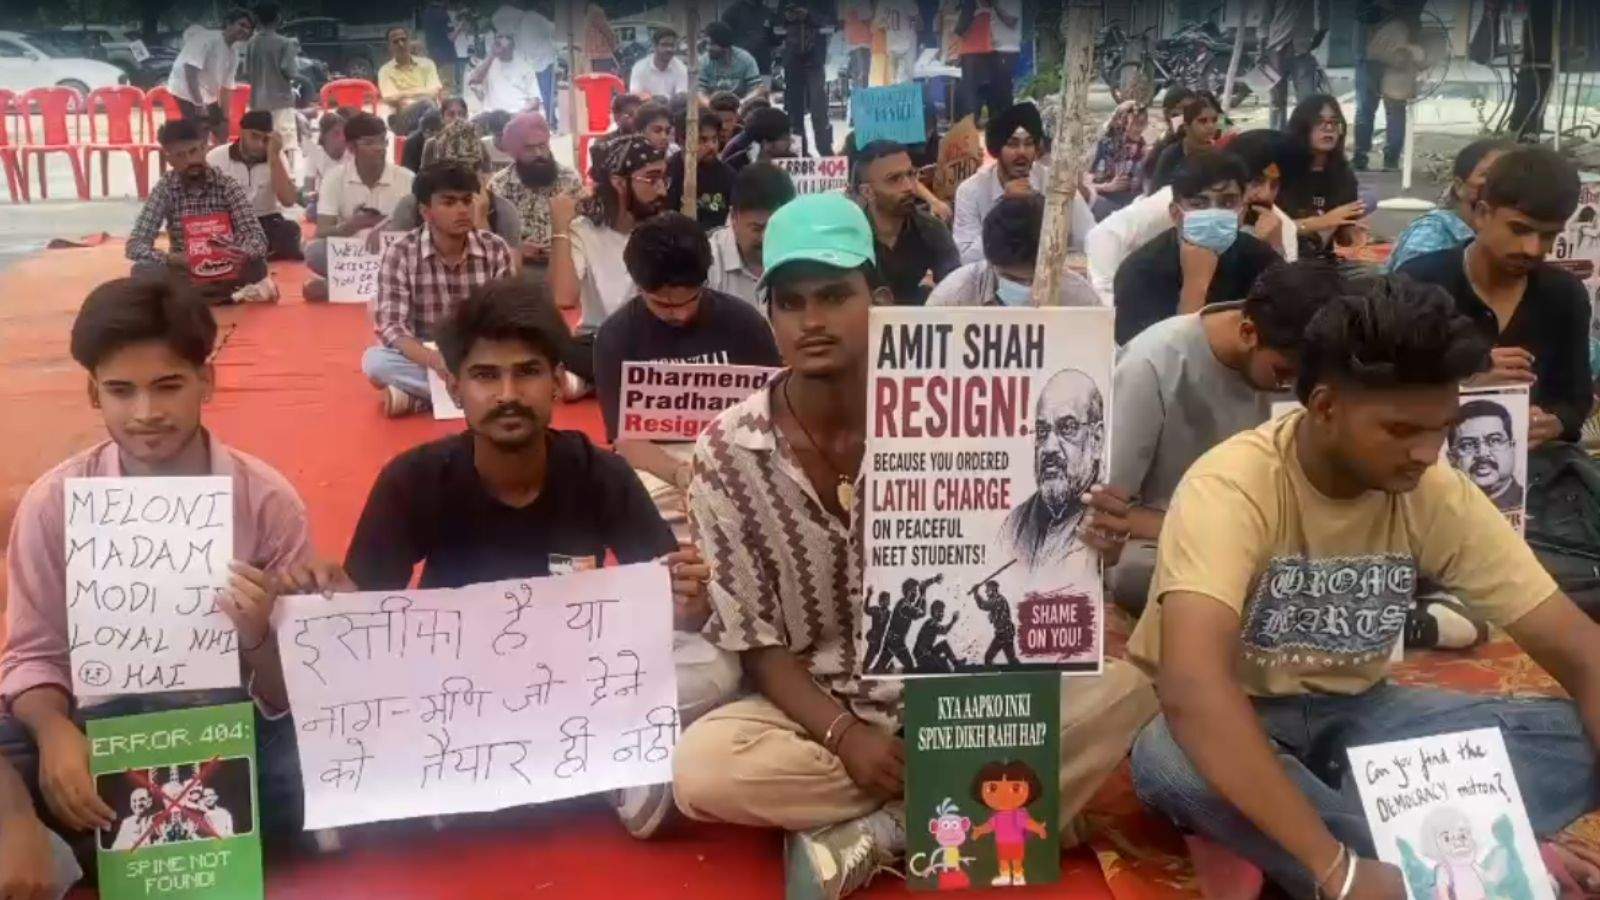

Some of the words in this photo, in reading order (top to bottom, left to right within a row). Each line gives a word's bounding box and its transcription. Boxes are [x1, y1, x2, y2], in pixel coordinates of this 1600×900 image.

[818, 160, 846, 177] 404
[877, 324, 953, 370] AMIT
[963, 324, 1045, 369] SHAH
[874, 376, 1030, 438] RESIGN!
[873, 452, 926, 472] BECAUSE
[930, 452, 951, 471] YOU
[956, 451, 1009, 471] ORDERED
[69, 488, 229, 530] MELONI
[872, 478, 926, 512] LATHI
[933, 478, 1011, 511] CHARGE
[872, 519, 891, 539] ON
[896, 518, 964, 539] PEACEFUL
[66, 535, 214, 575] MADAM
[872, 546, 906, 567] NEET
[911, 544, 986, 566] STUDENTS!
[69, 580, 157, 612] MODI
[491, 583, 533, 656] है
[565, 599, 620, 643] या
[1031, 603, 1078, 625] SHAME
[70, 623, 170, 653] LOYAL
[189, 627, 238, 655] NHI
[1027, 629, 1046, 649] ON
[1050, 627, 1082, 648] YOU!
[121, 663, 188, 689] HAI
[502, 662, 567, 712] जो
[586, 650, 647, 706] देने
[938, 696, 961, 720] KYA
[964, 694, 1003, 719] AAPKO
[1004, 693, 1031, 717] INKI
[92, 728, 192, 757] ERROR
[200, 720, 250, 743] 404:
[918, 726, 954, 751] SPINE
[954, 725, 986, 749] DIKH
[987, 723, 1018, 747] RAHI
[1019, 721, 1046, 746] HAI?
[319, 738, 375, 792] को
[420, 727, 532, 789] तैयार
[554, 715, 597, 778] ही
[1366, 759, 1390, 785] Can
[1391, 755, 1412, 789] you
[1419, 745, 1450, 782] find
[1457, 737, 1487, 760] the
[1376, 780, 1448, 823] DEMOCRACY
[1457, 771, 1512, 803] mitron?
[126, 856, 185, 879] SPINE
[190, 851, 232, 868] NOT
[144, 871, 216, 897] FOUND!
